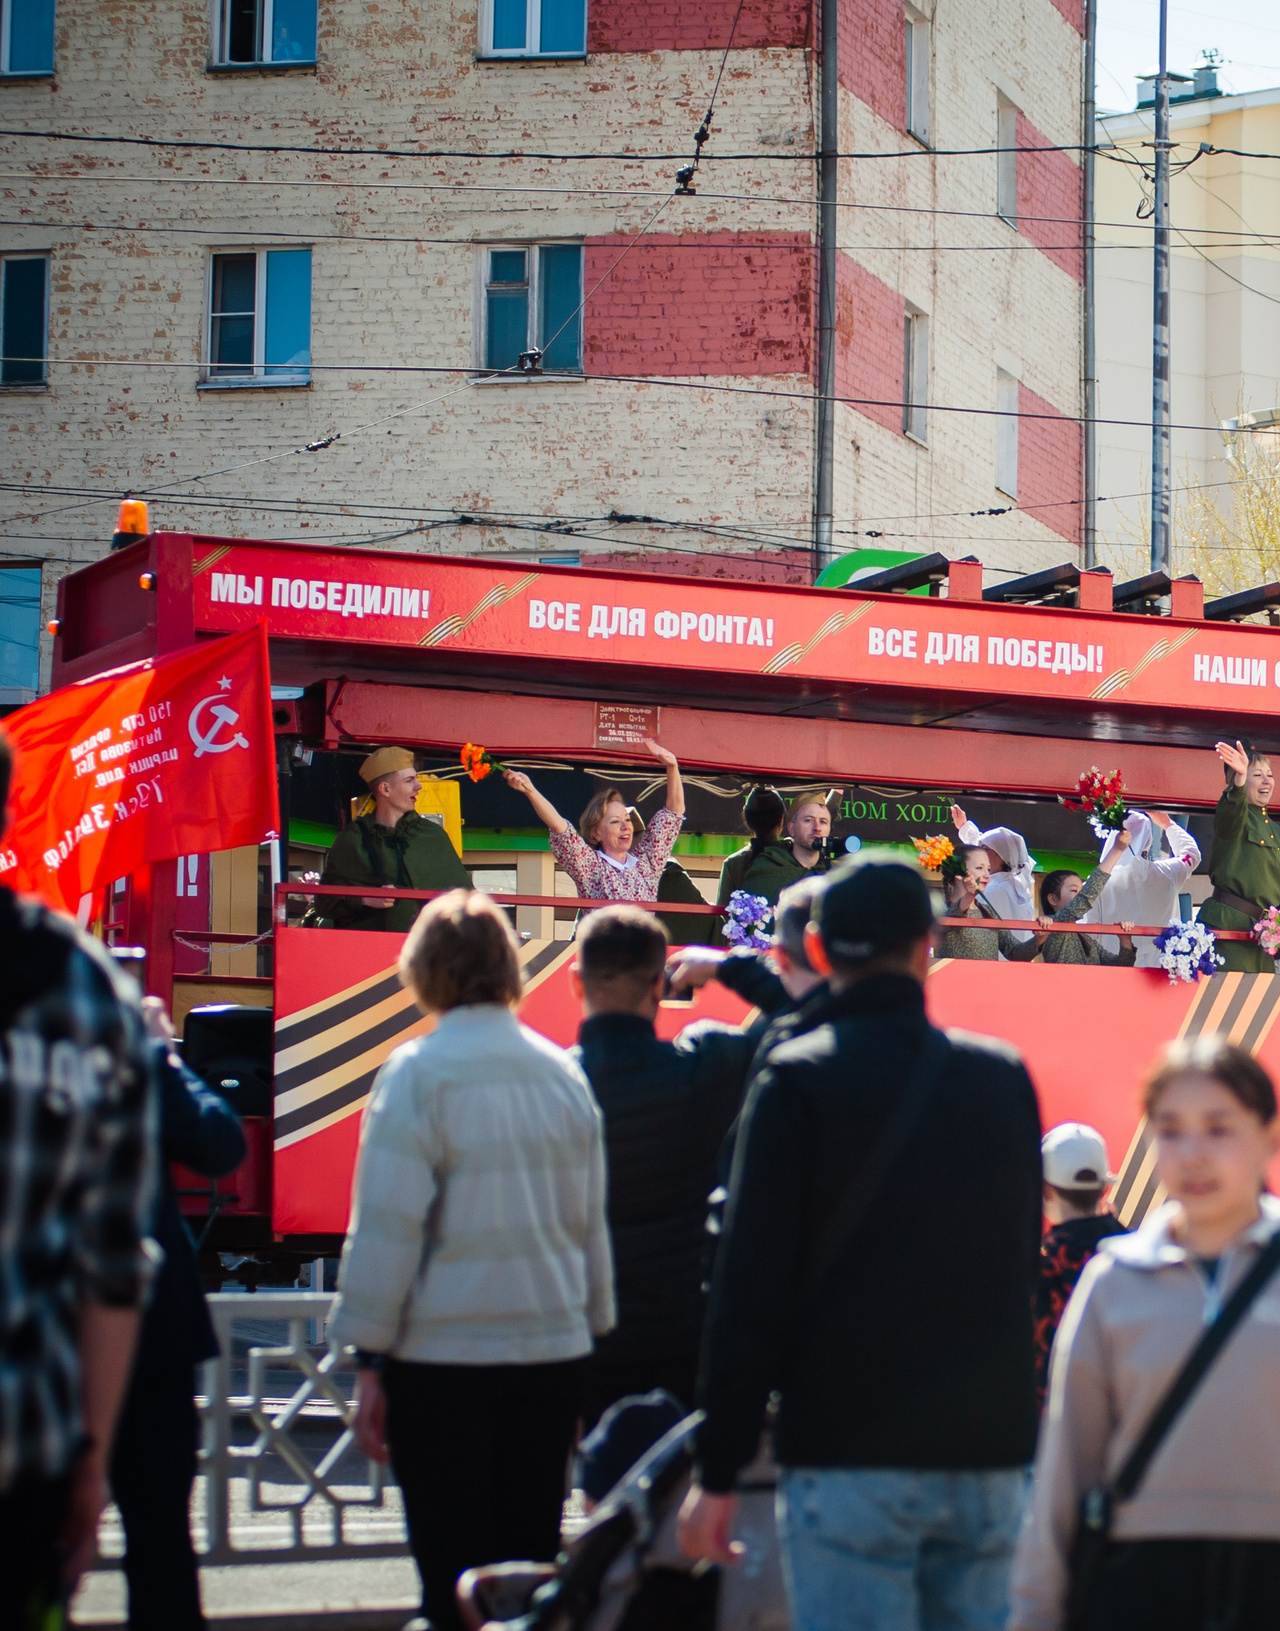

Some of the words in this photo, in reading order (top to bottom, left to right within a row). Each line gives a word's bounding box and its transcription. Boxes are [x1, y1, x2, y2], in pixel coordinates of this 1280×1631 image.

[211, 572, 263, 606] МЫ
[271, 577, 430, 618] ПОБЕДИЛИ!
[528, 599, 581, 632] ВСЕ
[588, 605, 647, 639] ДЛЯ
[653, 610, 775, 647] ФРОНТА!
[868, 627, 918, 659] ВСЕ
[924, 632, 980, 665] ДЛЯ
[987, 636, 1104, 675] ПОБЕДЫ!
[1193, 653, 1267, 687] НАШИ
